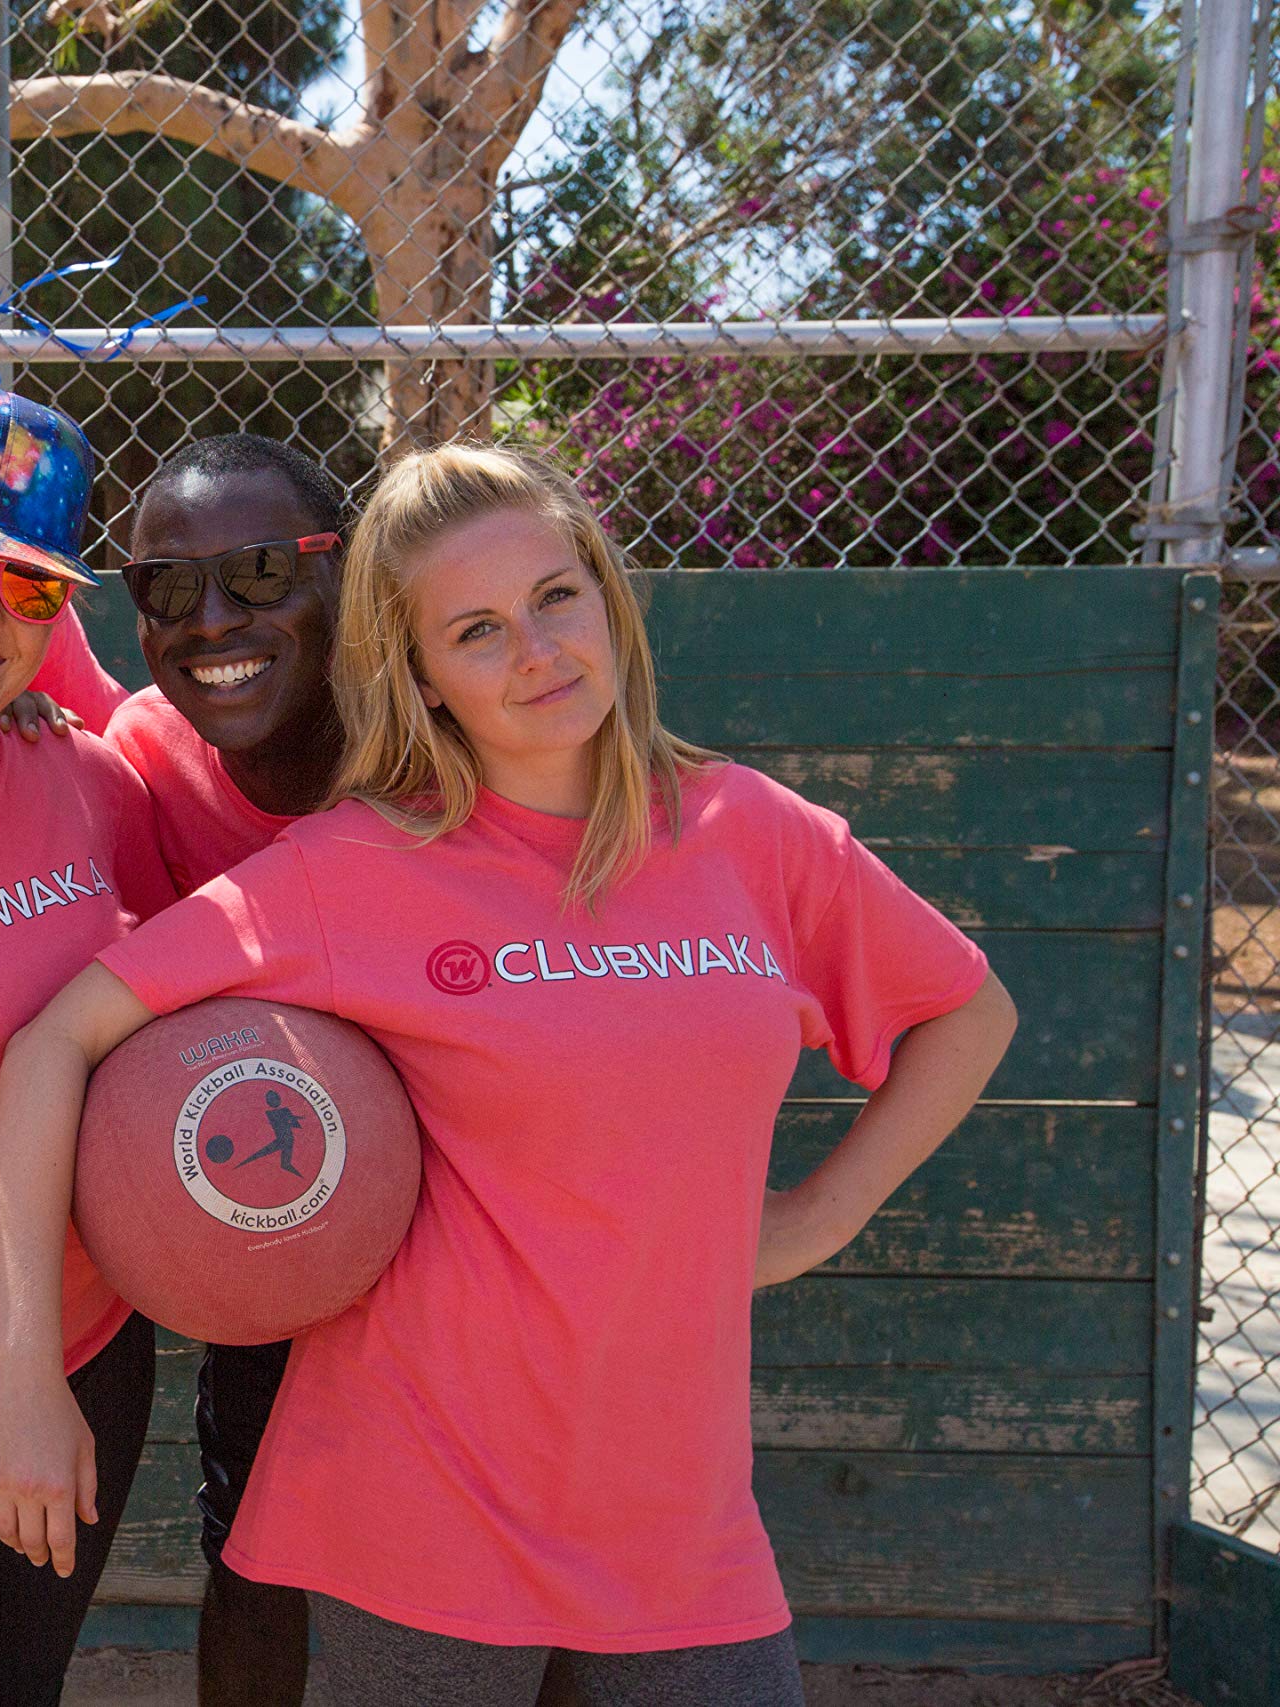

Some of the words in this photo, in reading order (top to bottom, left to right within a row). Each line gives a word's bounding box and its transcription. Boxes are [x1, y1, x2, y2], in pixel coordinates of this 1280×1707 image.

[494, 933, 787, 984] CLUBWAKA
[179, 1027, 259, 1065] WAKA
[184, 1064, 245, 1120] Kickball
[255, 1062, 338, 1132] Association
[178, 1128, 200, 1182] World
[230, 1184, 330, 1229] kickball.com
